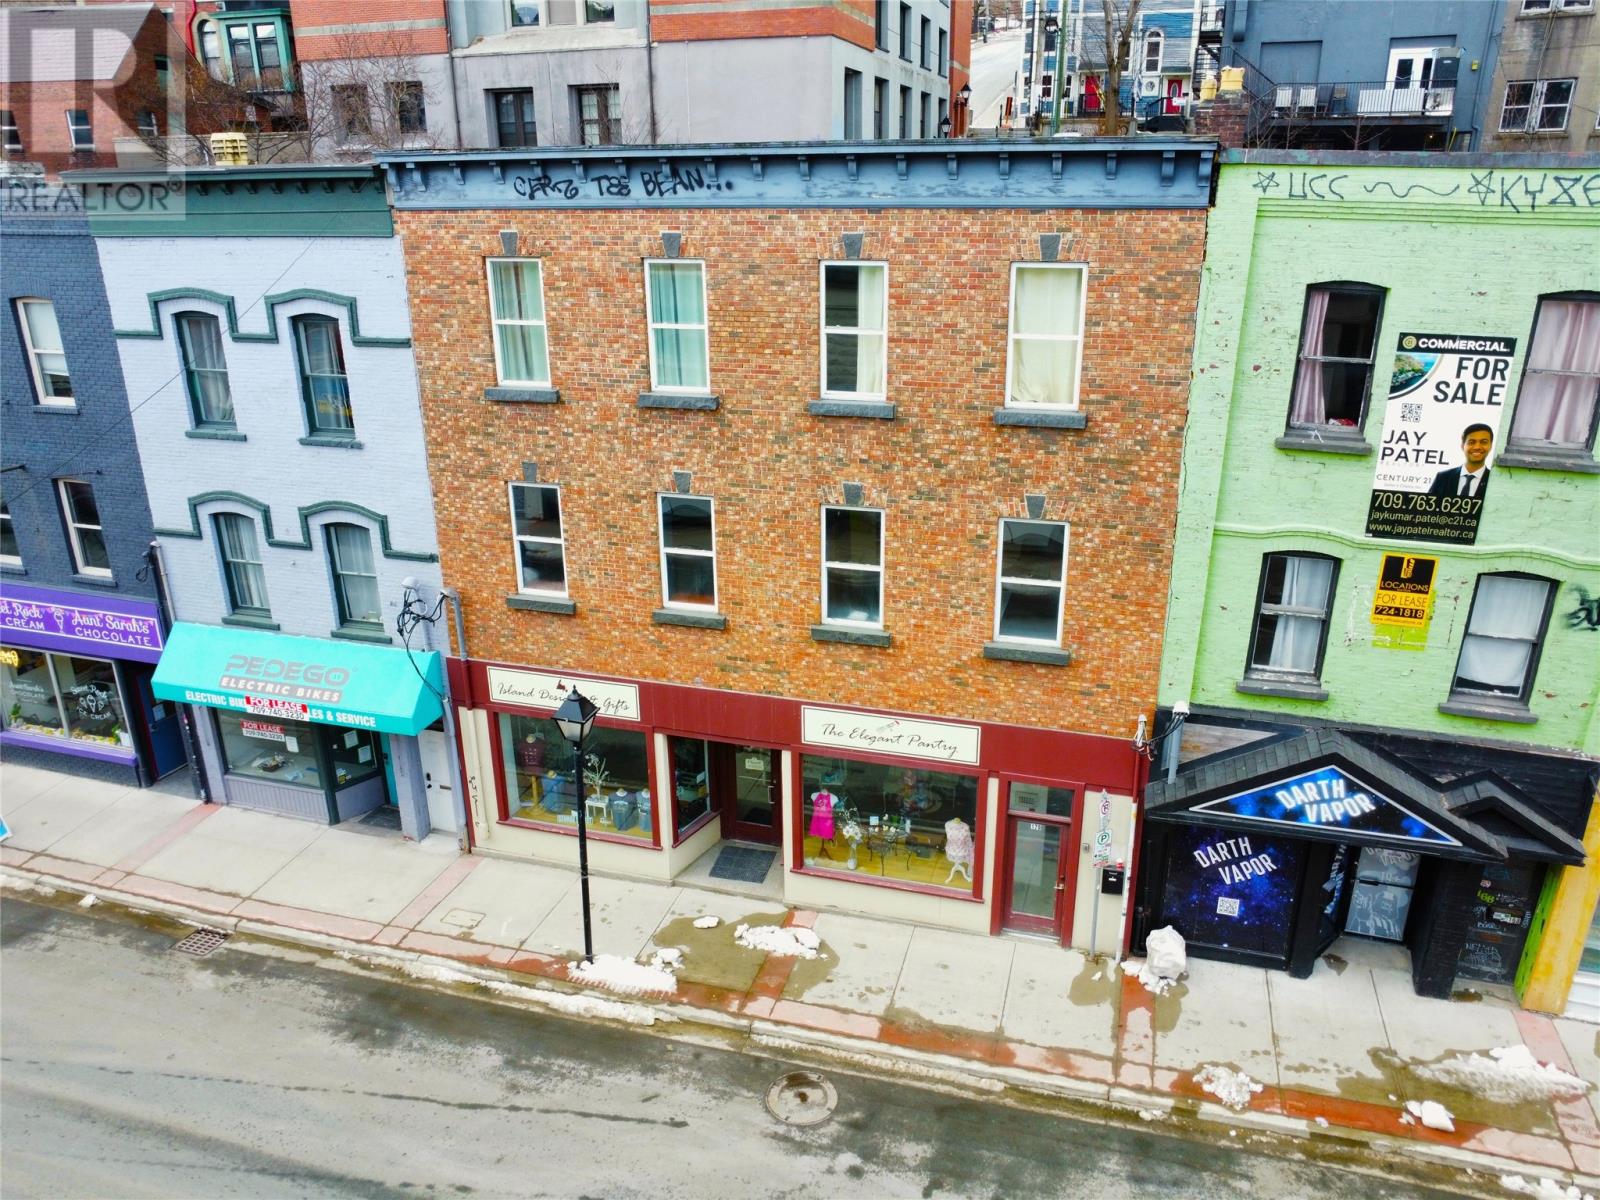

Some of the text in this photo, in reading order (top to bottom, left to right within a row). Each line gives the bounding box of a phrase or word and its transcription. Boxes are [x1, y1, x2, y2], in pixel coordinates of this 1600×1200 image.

[1418, 338, 1509, 351] COMMERCIAL
[1455, 356, 1510, 382] FOR
[1433, 380, 1505, 406] SALE
[1383, 430, 1427, 446] JAY
[1380, 446, 1450, 465] PATEL
[1376, 473, 1421, 484] CENTURY
[1374, 491, 1482, 515] 709.763.6297
[1370, 509, 1477, 527] jaykumar.patel@c21.ca
[1369, 522, 1474, 539] www.jaypatelrealtor.ca
[1381, 581, 1429, 592] LOCATIONS
[1375, 605, 1424, 618] 724-1818
[1376, 593, 1427, 608] FOR LEASE
[12, 602, 43, 621] Rock
[71, 610, 104, 628] Aunt
[105, 615, 150, 635] Sarah's
[5, 617, 152, 647] CREAM CHOCOLATE
[224, 655, 350, 687] PEDEGO
[221, 677, 341, 702] ELECTRIC BIKES
[497, 681, 535, 698] Island
[603, 697, 631, 717] Gifts
[185, 690, 228, 706] ELECTRIC
[326, 710, 335, 721] &
[335, 712, 377, 728] SERVICE
[250, 697, 303, 713] FOR LEASE
[251, 705, 305, 720] 709-740-3230
[243, 721, 282, 733] FOR LEASE
[822, 723, 959, 759] The Elegant Pantry
[1275, 778, 1347, 810] DARTH
[1304, 792, 1376, 824] VAPOR
[1193, 836, 1253, 869] DARTH
[1218, 854, 1277, 885] VAPOR
